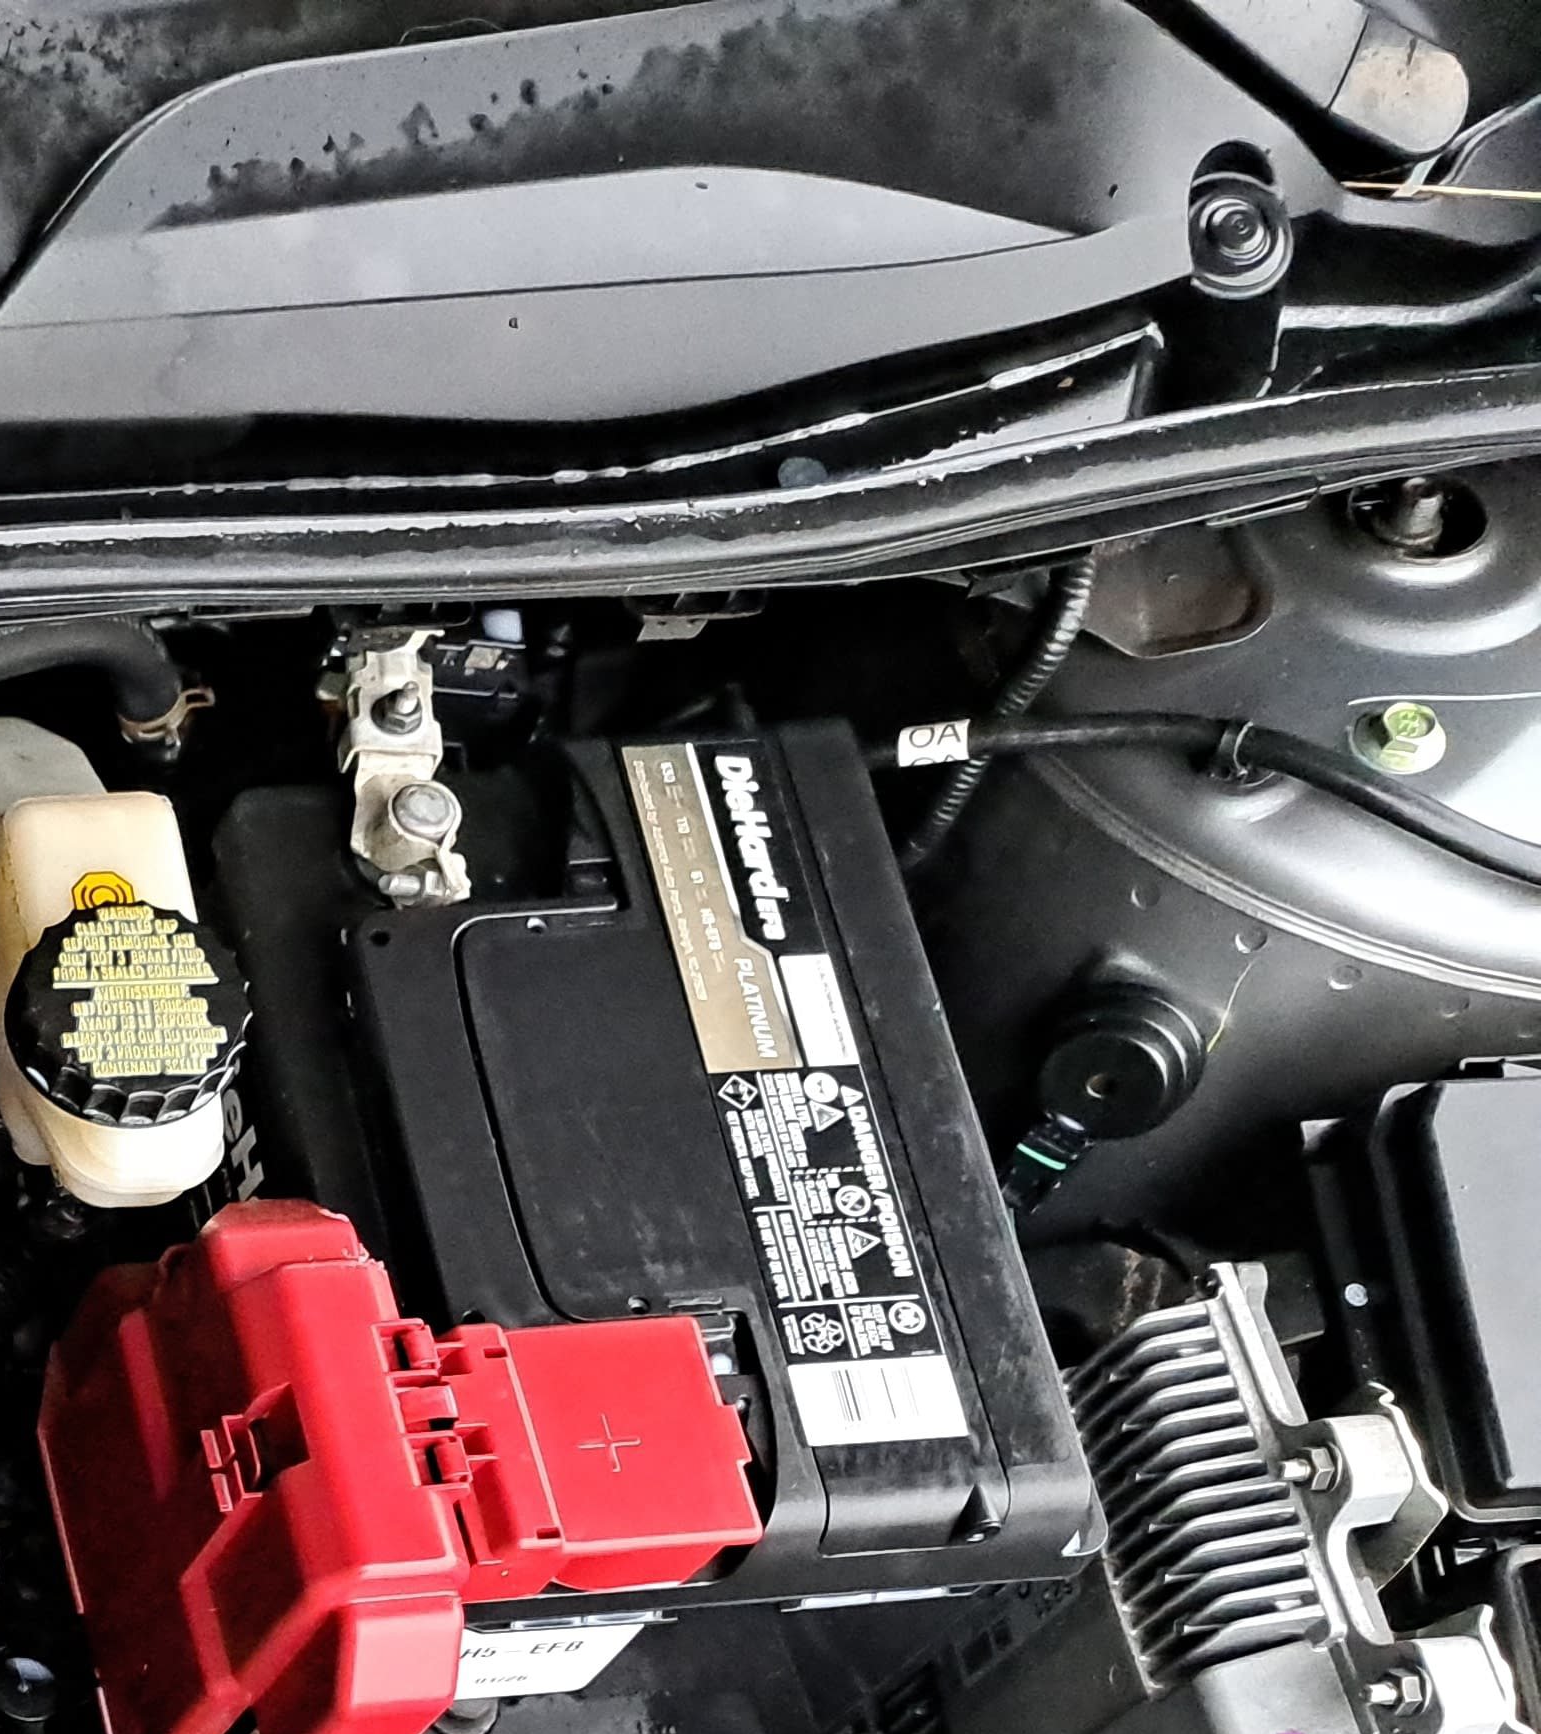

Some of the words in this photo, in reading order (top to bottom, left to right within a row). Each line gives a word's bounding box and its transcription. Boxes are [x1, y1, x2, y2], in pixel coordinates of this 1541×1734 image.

[715, 753, 790, 902] DieHard
[732, 957, 777, 1059] PLATINUM
[847, 1103, 913, 1280] DANGER/POISON
